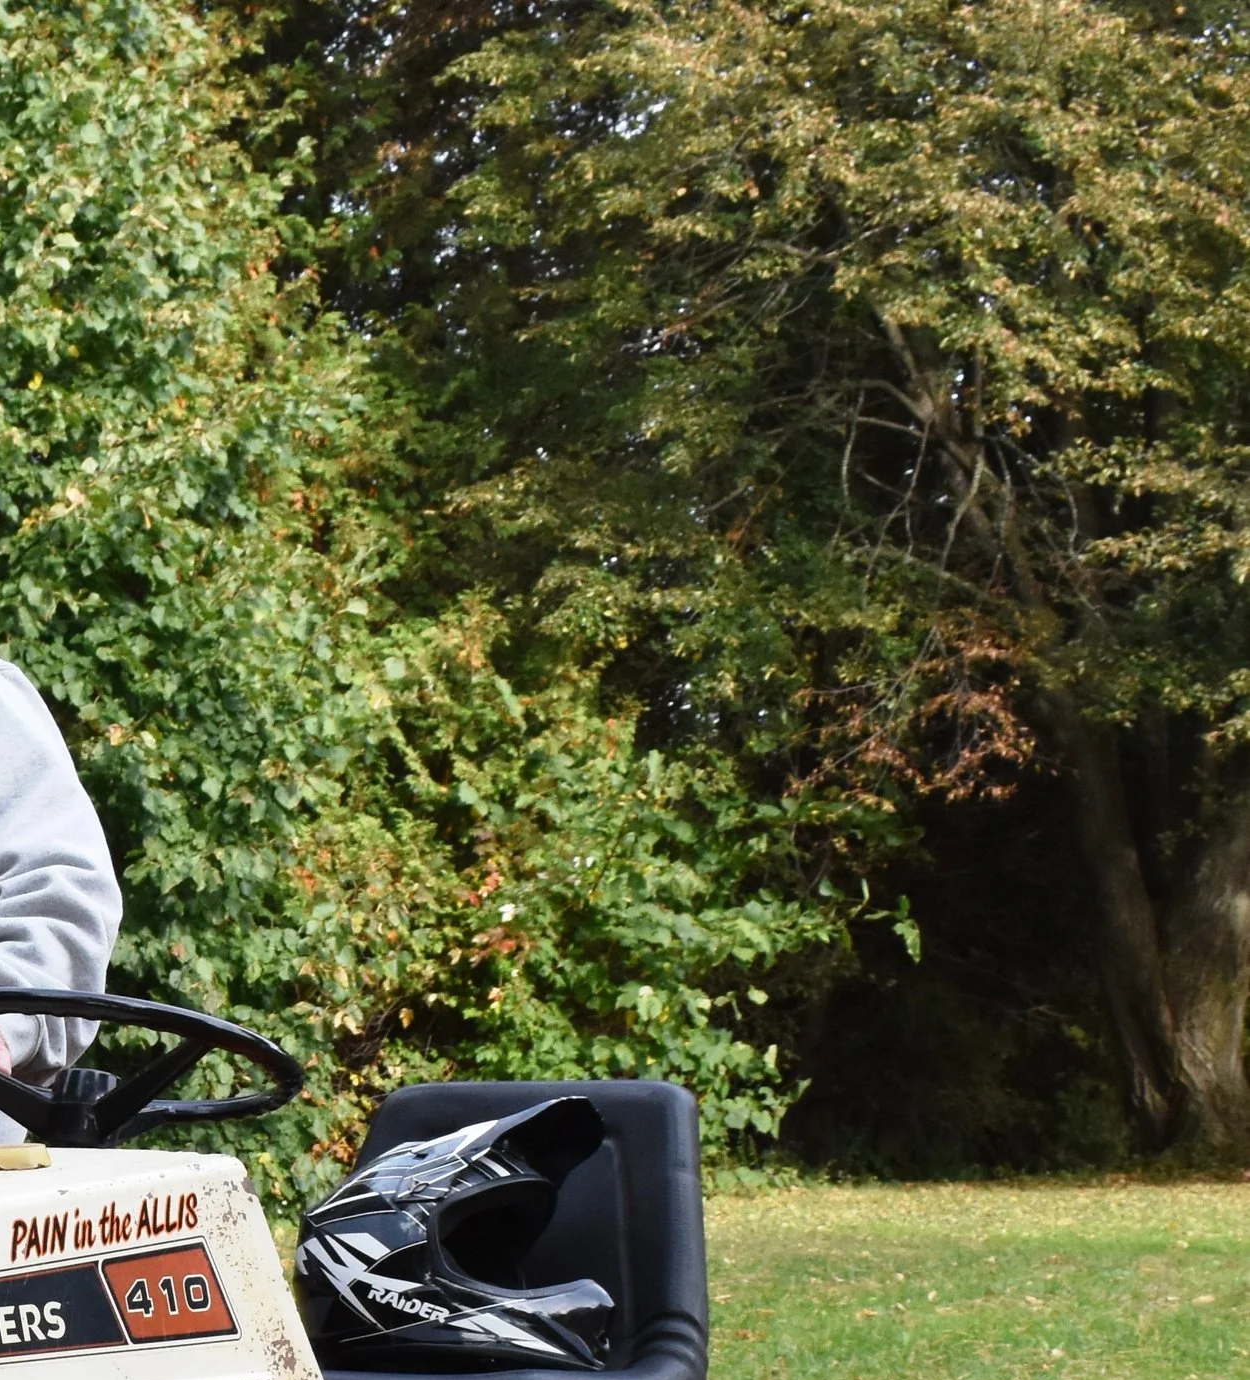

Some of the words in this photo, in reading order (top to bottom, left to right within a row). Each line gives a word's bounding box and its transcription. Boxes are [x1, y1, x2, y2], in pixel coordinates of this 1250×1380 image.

[10, 1211, 68, 1264] PAIN
[73, 1207, 96, 1251] in
[99, 1201, 132, 1246] the
[136, 1192, 198, 1240] ALLIS
[125, 1274, 211, 1317] 410
[367, 1285, 450, 1324] RAIDER
